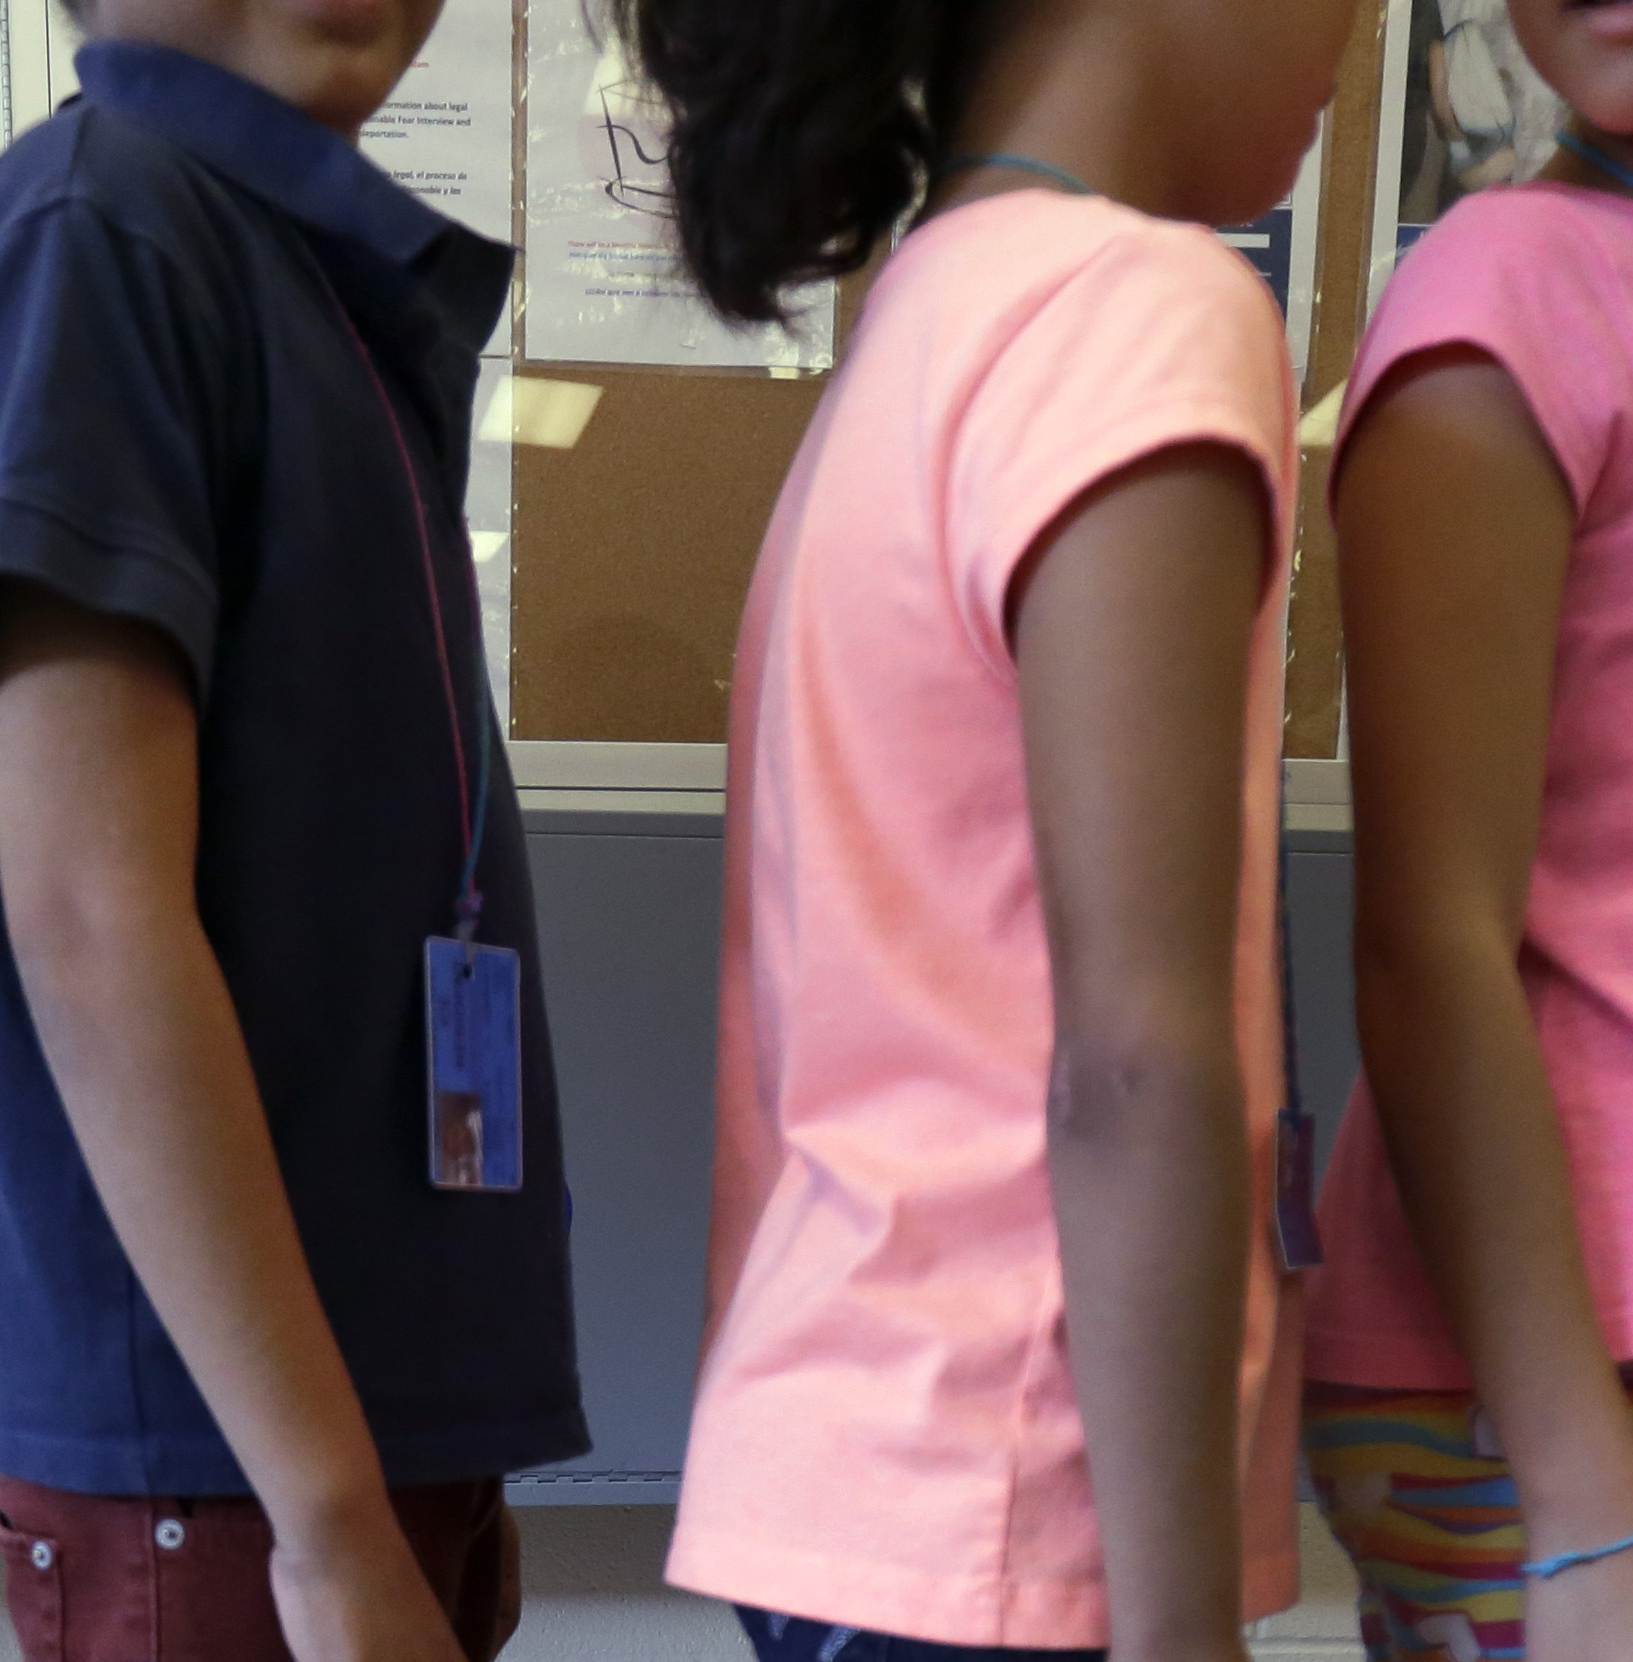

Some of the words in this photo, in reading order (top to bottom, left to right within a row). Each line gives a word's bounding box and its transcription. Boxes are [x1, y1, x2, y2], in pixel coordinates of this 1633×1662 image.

[384, 102, 422, 110] ormation
[424, 102, 447, 110] about
[449, 103, 467, 112] legal
[398, 116, 416, 124] Fear
[417, 117, 454, 125] Interview
[456, 118, 471, 126] and
[425, 172, 456, 180] proceso
[458, 172, 467, 180] de
